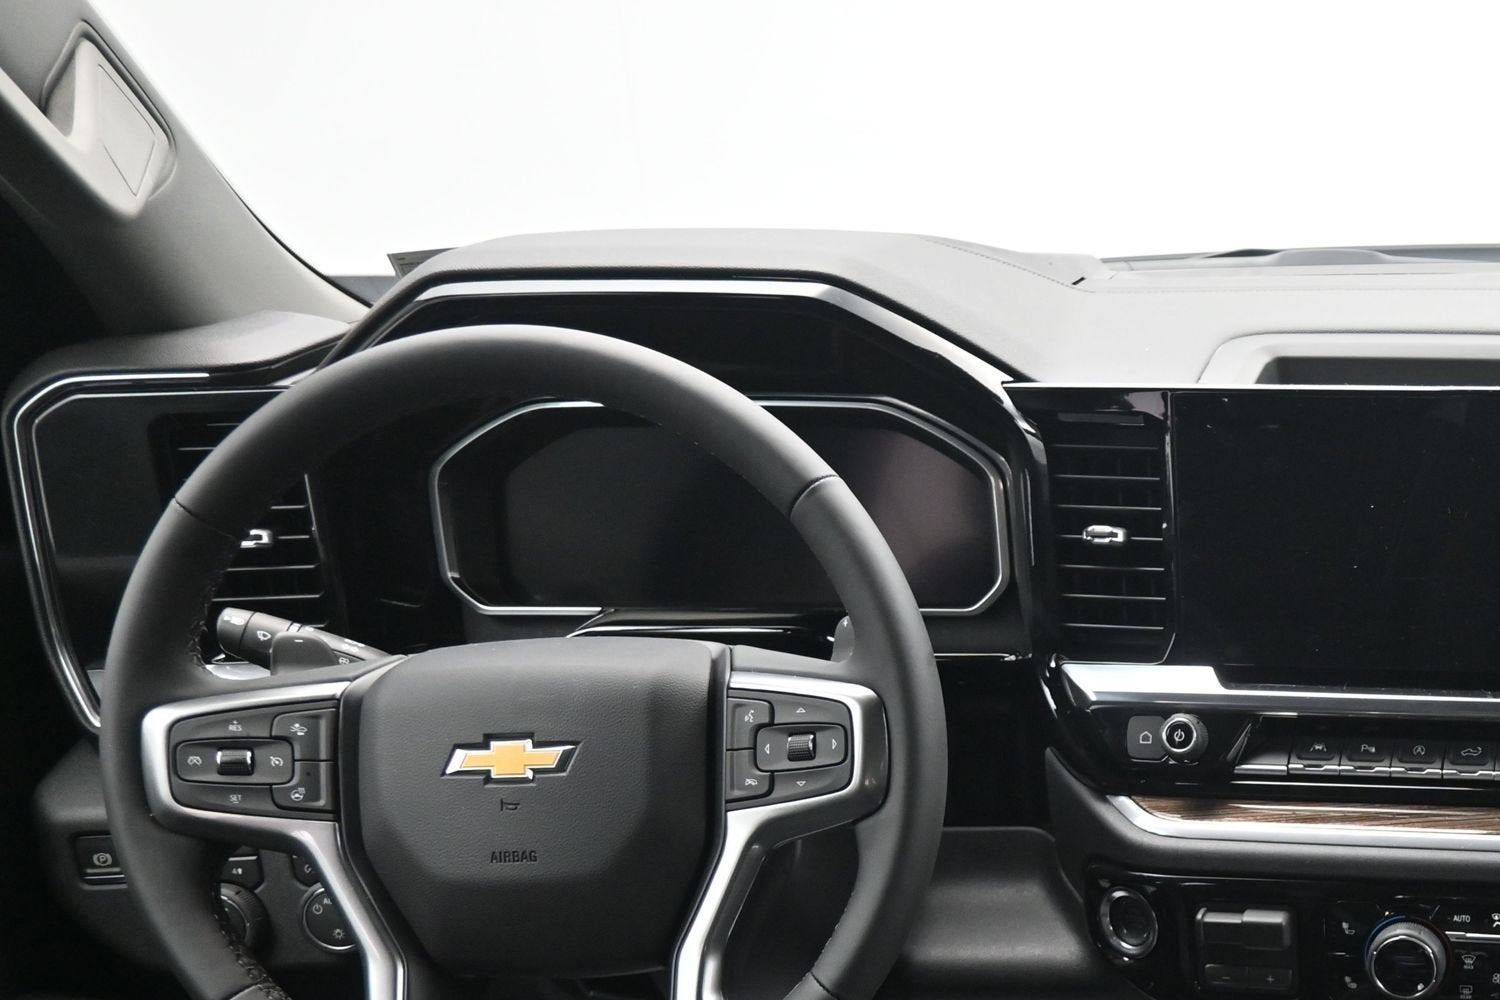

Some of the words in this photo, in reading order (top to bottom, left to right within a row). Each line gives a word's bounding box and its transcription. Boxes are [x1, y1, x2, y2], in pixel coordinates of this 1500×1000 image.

[228, 723, 243, 732] RES
[229, 794, 242, 802] SET
[490, 850, 538, 863] AIRBAG
[1452, 914, 1471, 923] AUTO
